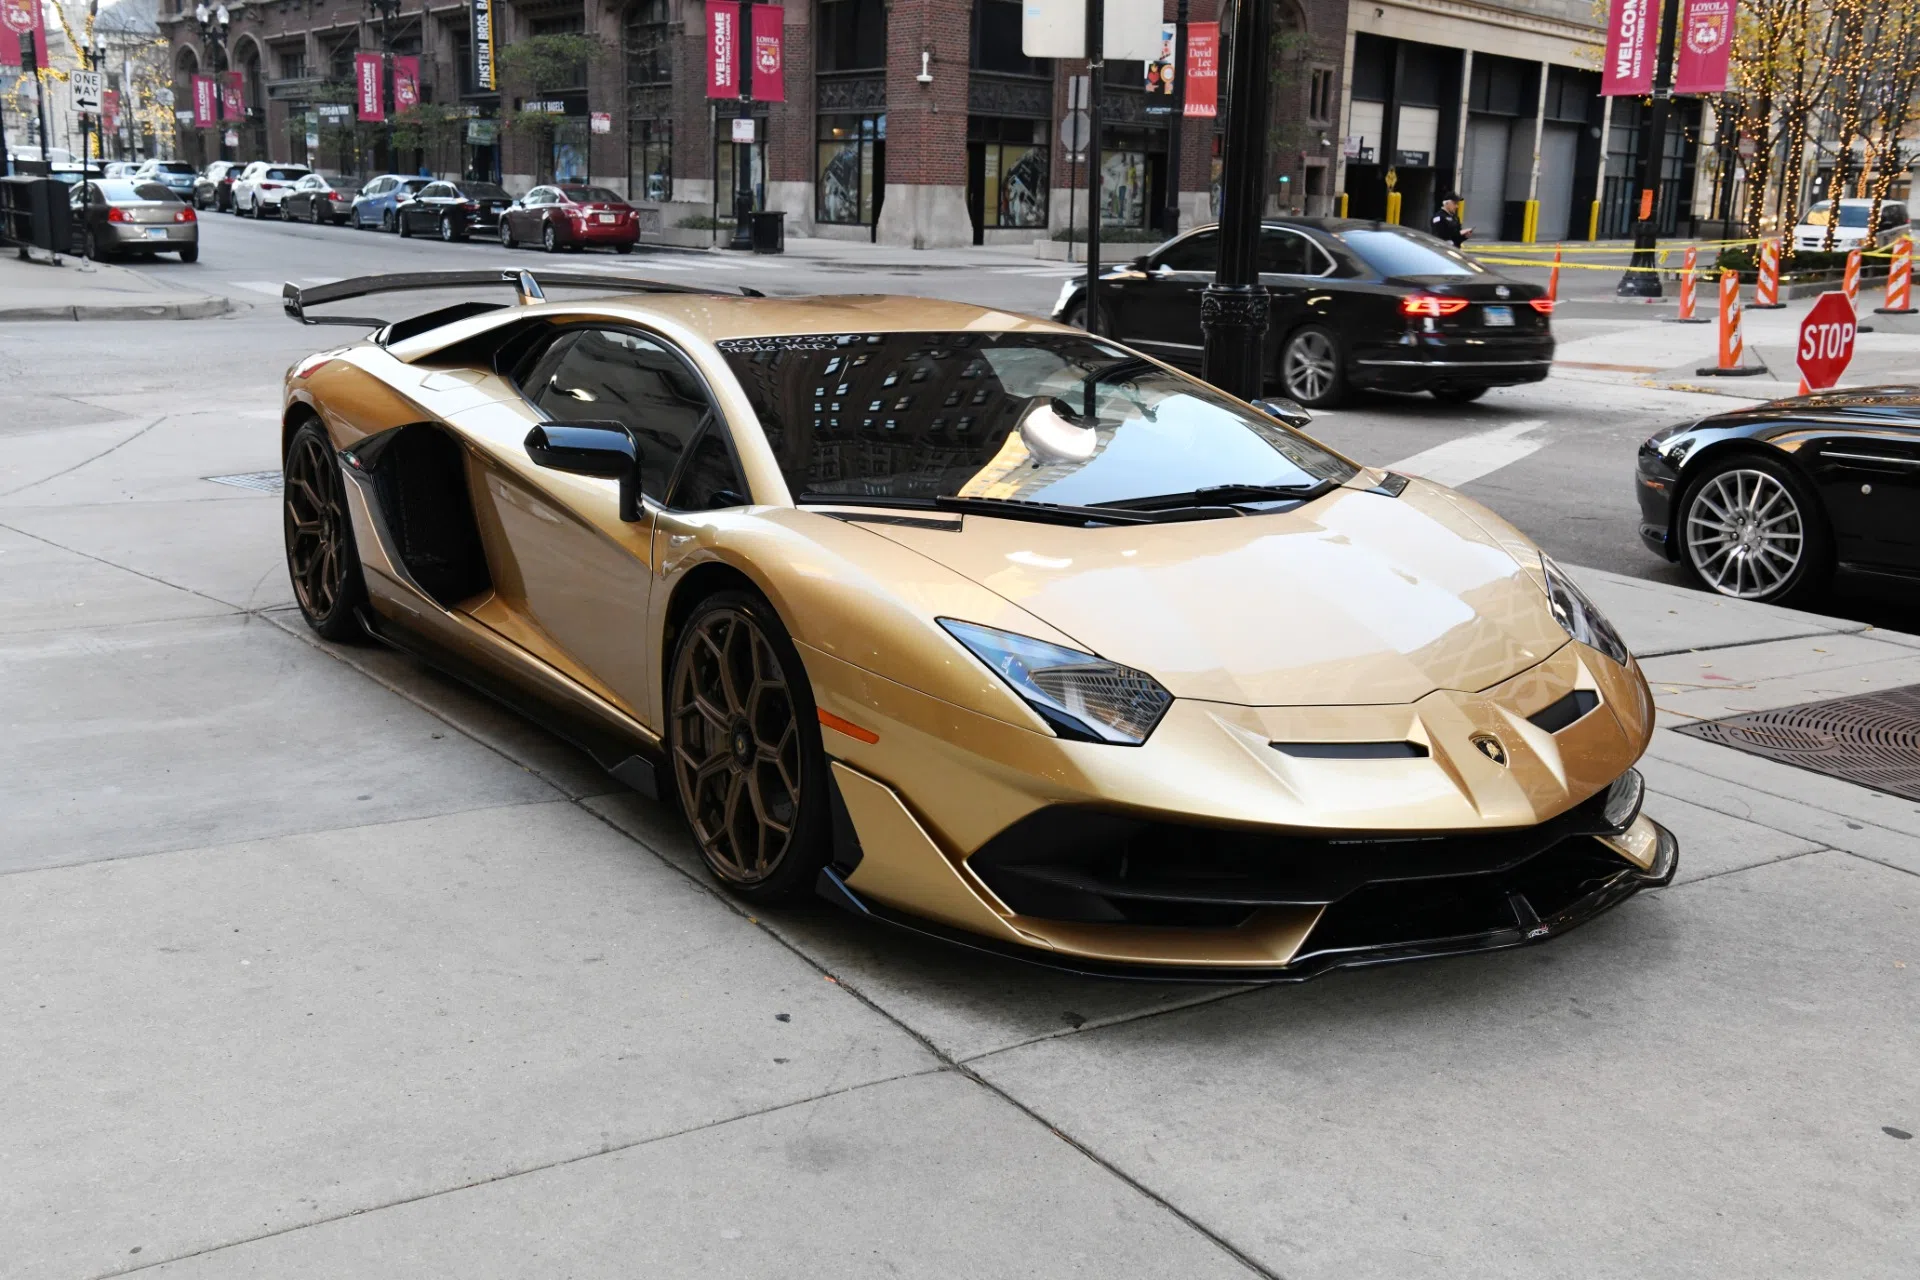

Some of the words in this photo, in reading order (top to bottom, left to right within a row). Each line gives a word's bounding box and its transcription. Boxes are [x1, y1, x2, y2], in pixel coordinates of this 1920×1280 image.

[1690, 2, 1729, 11] LOYOLA
[1635, 18, 1645, 48] TOWER
[715, 12, 725, 86] WELCOME
[1189, 47, 1211, 57] David
[1198, 58, 1211, 67] Lee
[1632, 50, 1642, 79] WATER
[74, 73, 98, 85] ONE
[74, 85, 98, 97] WAY
[363, 62, 373, 113] WELCOME
[1184, 104, 1216, 114] LUMA
[1801, 322, 1854, 361] STOP
